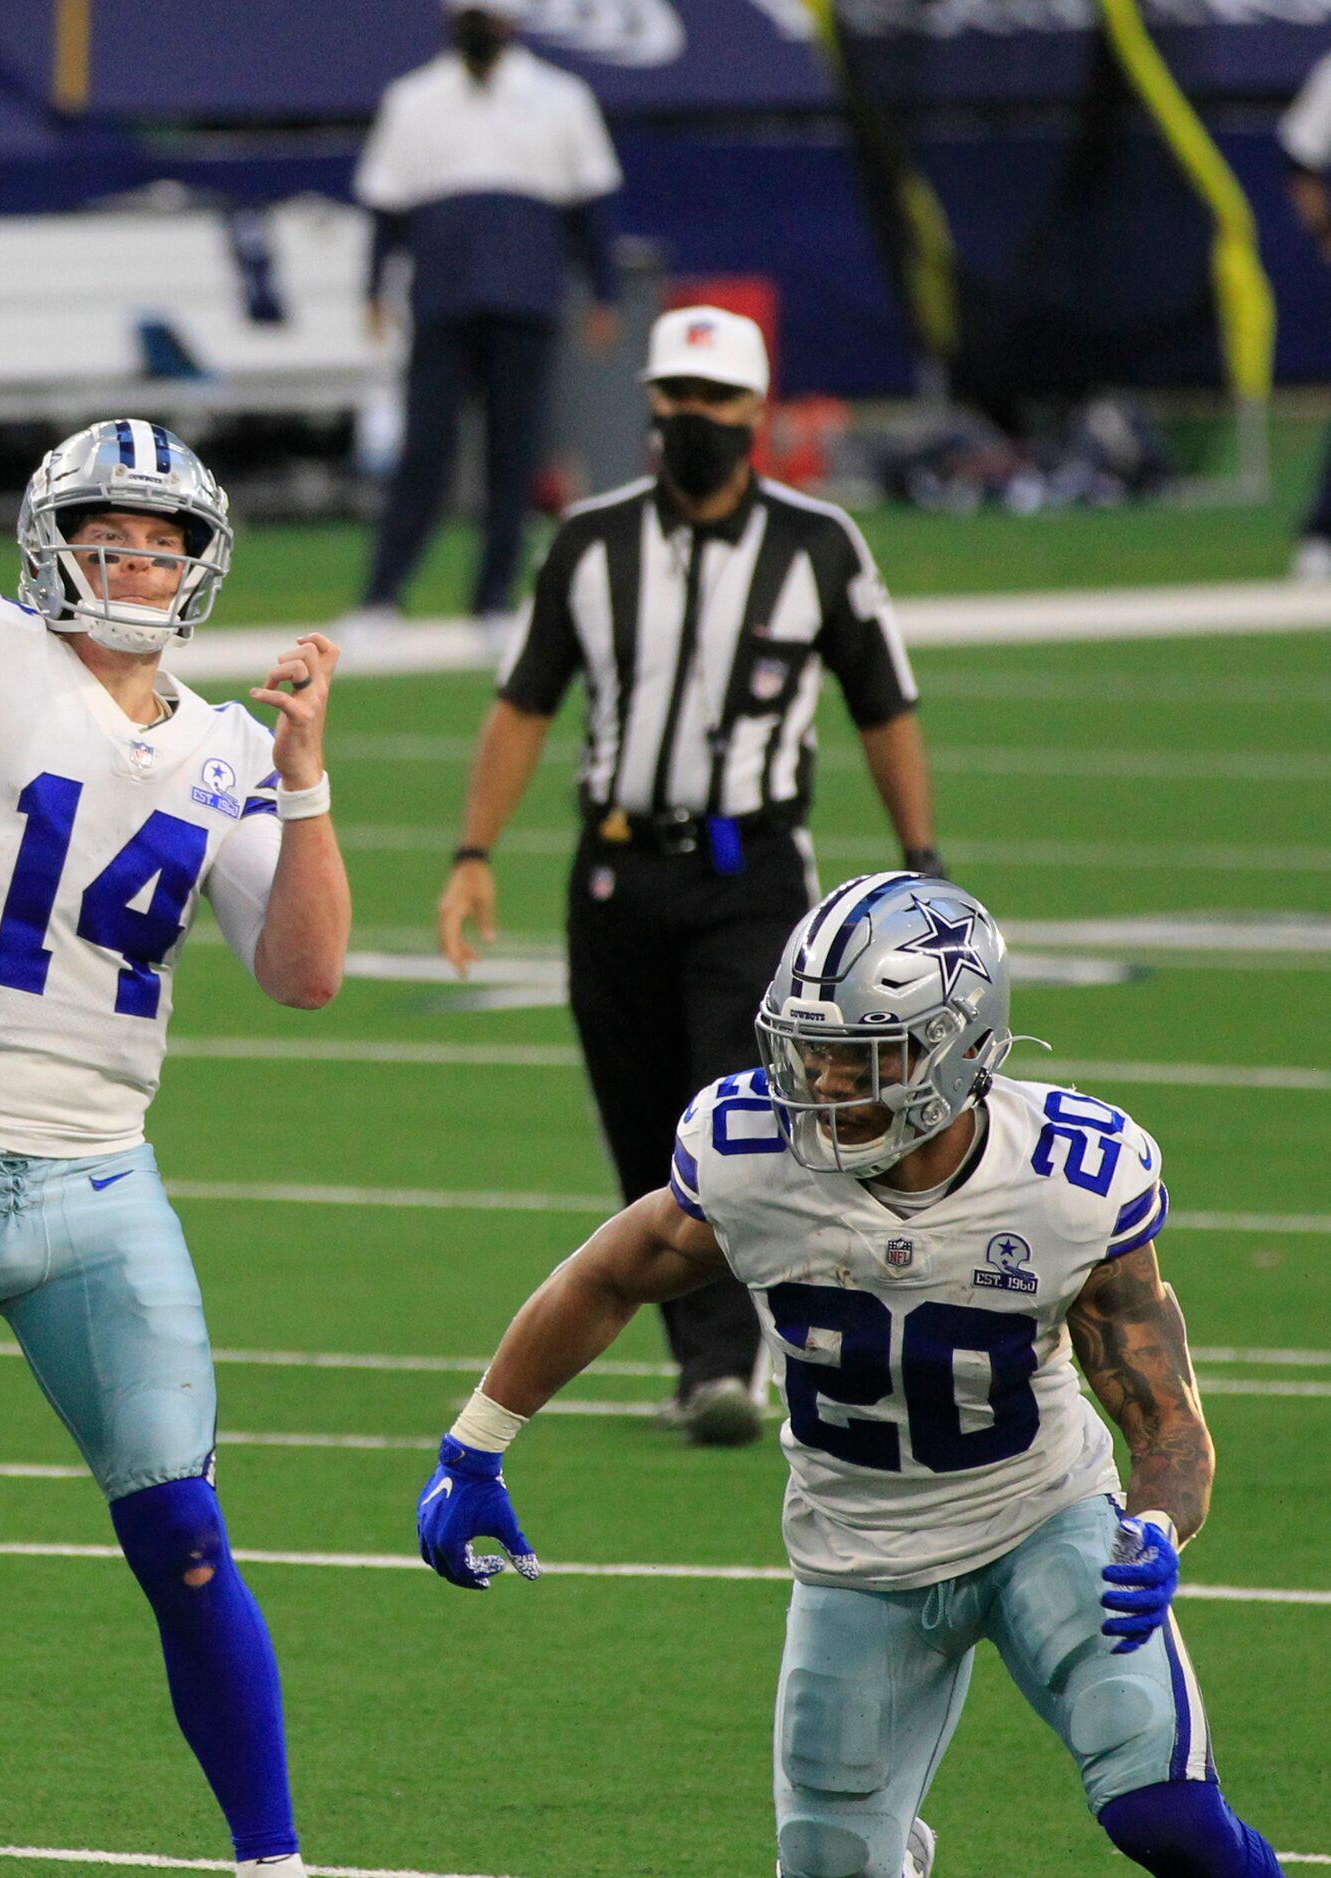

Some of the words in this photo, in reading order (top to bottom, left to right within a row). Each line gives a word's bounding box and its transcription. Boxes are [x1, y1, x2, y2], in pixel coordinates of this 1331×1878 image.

[789, 1009, 826, 1022] COWBOYS
[1030, 1089, 1126, 1198] 20
[975, 1271, 1004, 1288] EST.
[1007, 1276, 1036, 1293] 1960
[766, 1281, 1041, 1474] 20
